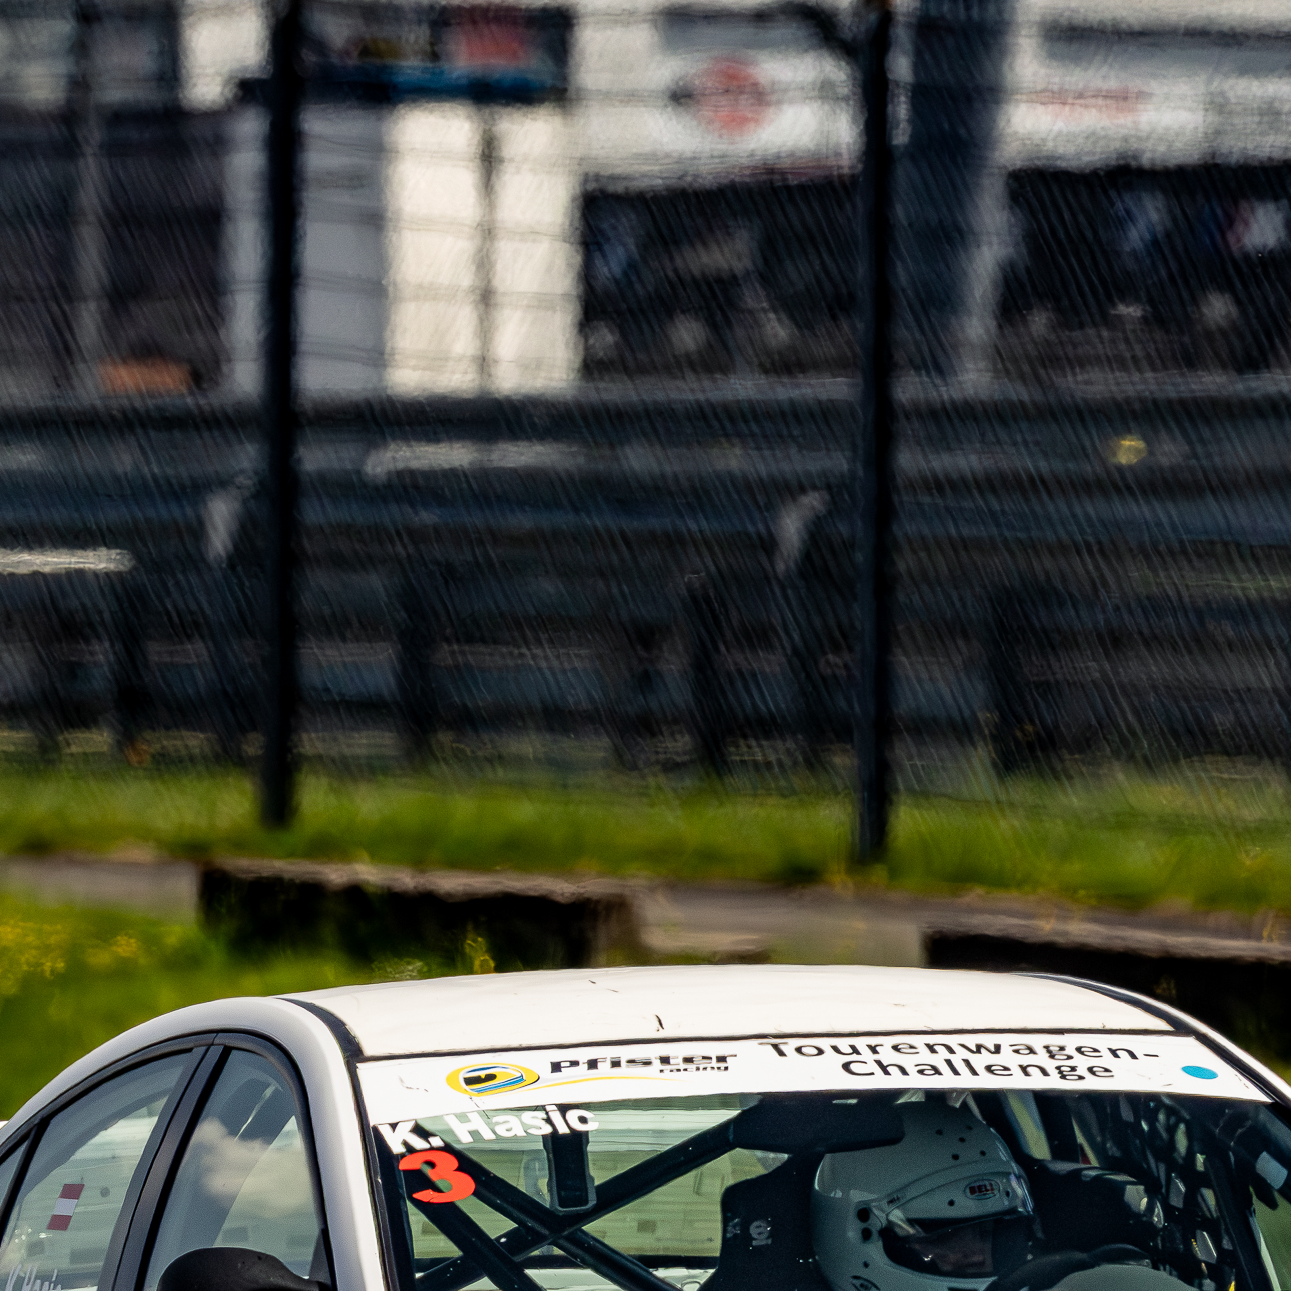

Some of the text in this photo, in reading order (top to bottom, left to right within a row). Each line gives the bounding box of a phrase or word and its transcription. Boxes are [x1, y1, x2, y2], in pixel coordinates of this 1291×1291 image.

[757, 1041, 1161, 1061] Tourenwagen-
[549, 1053, 738, 1074] Pfister
[840, 1058, 1116, 1081] Challenge
[443, 1104, 600, 1144] Hasic
[398, 1150, 476, 1204] 3
[968, 1181, 997, 1196] BELL
